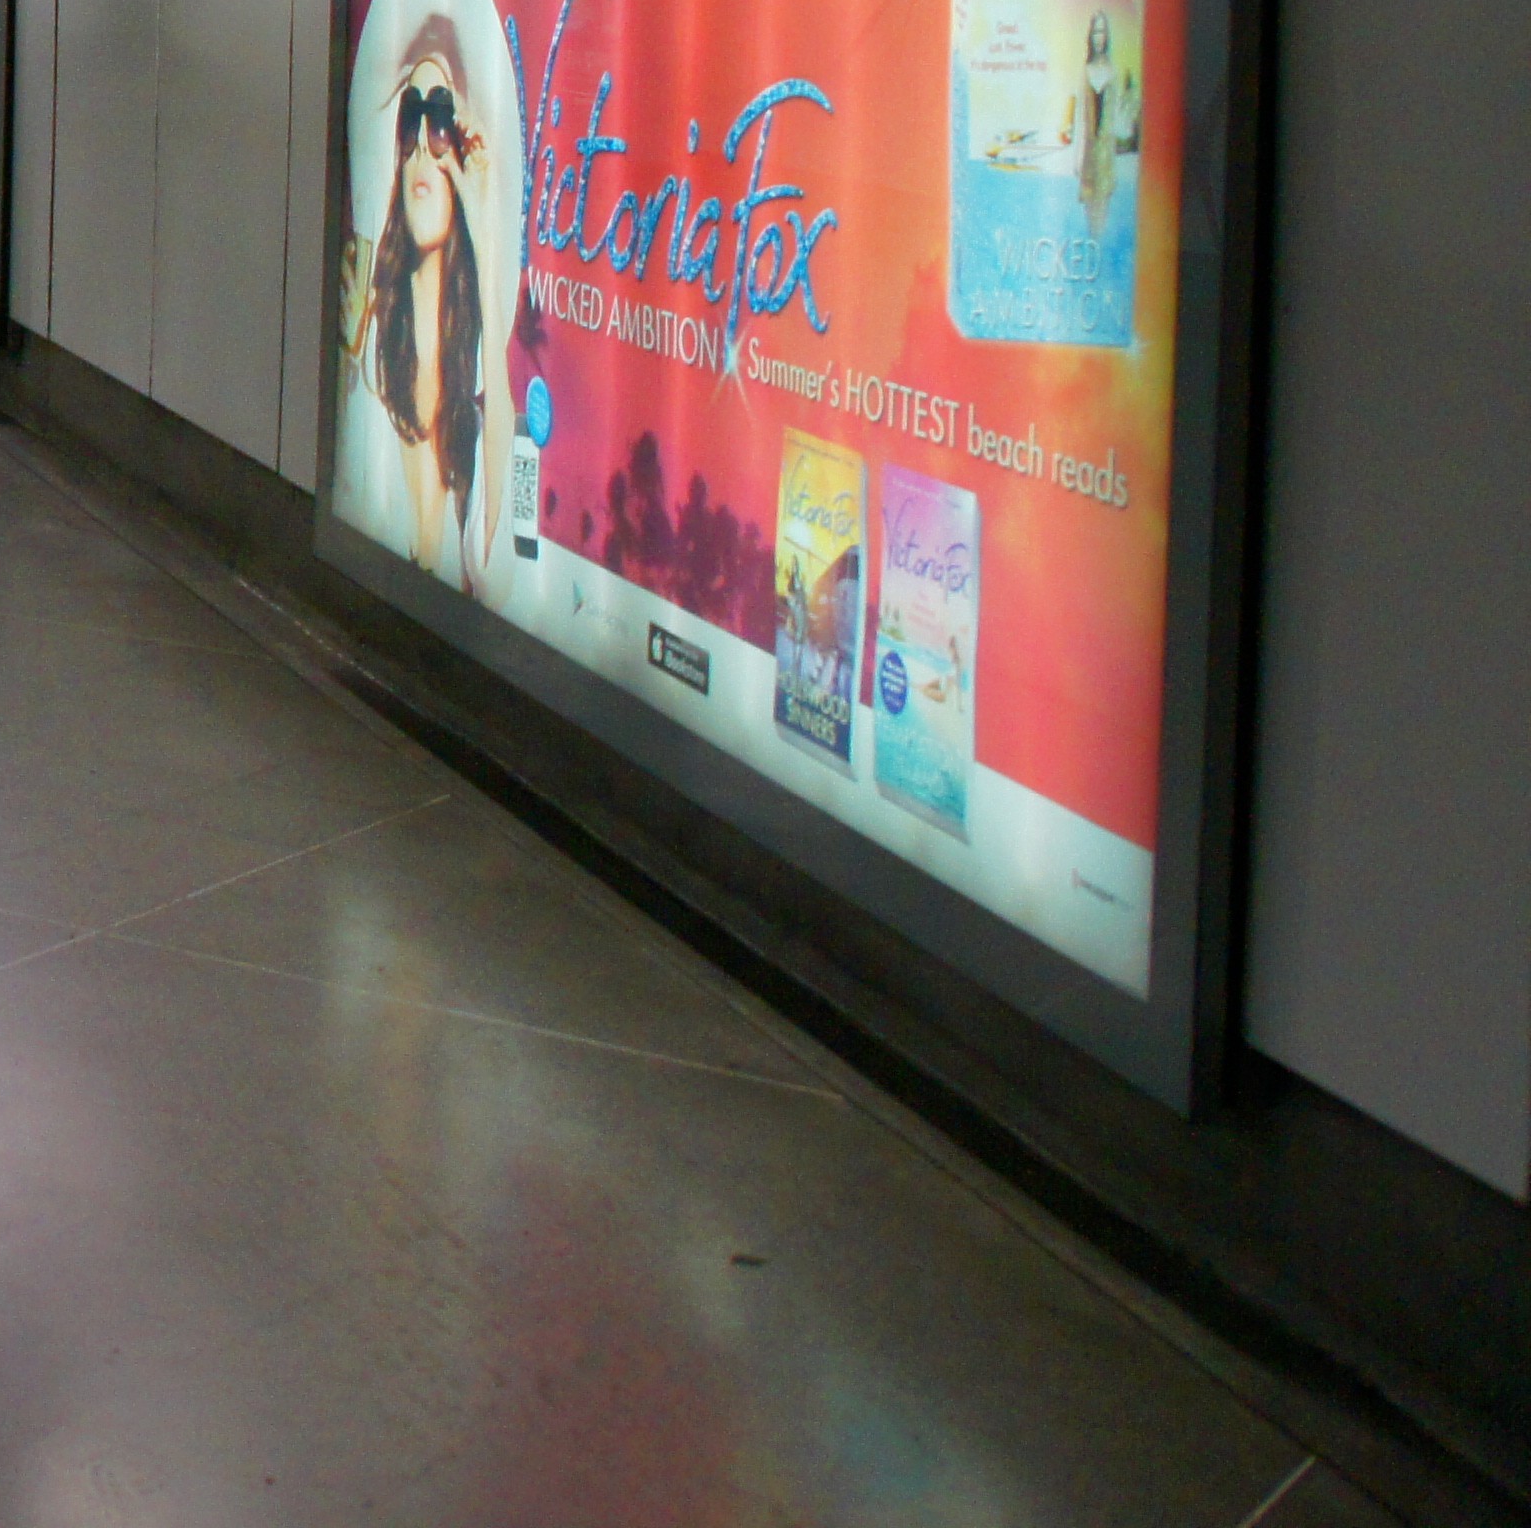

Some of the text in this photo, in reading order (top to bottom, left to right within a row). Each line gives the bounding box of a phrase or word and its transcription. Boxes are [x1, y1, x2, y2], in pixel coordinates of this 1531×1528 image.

[722, 78, 838, 367] Fox
[527, 264, 604, 332] WICKED
[606, 294, 720, 372] AMBITION
[746, 336, 841, 409] Summer's
[845, 368, 959, 449] HOTTEST
[967, 402, 1044, 480] beach
[1051, 446, 1129, 511] reads
